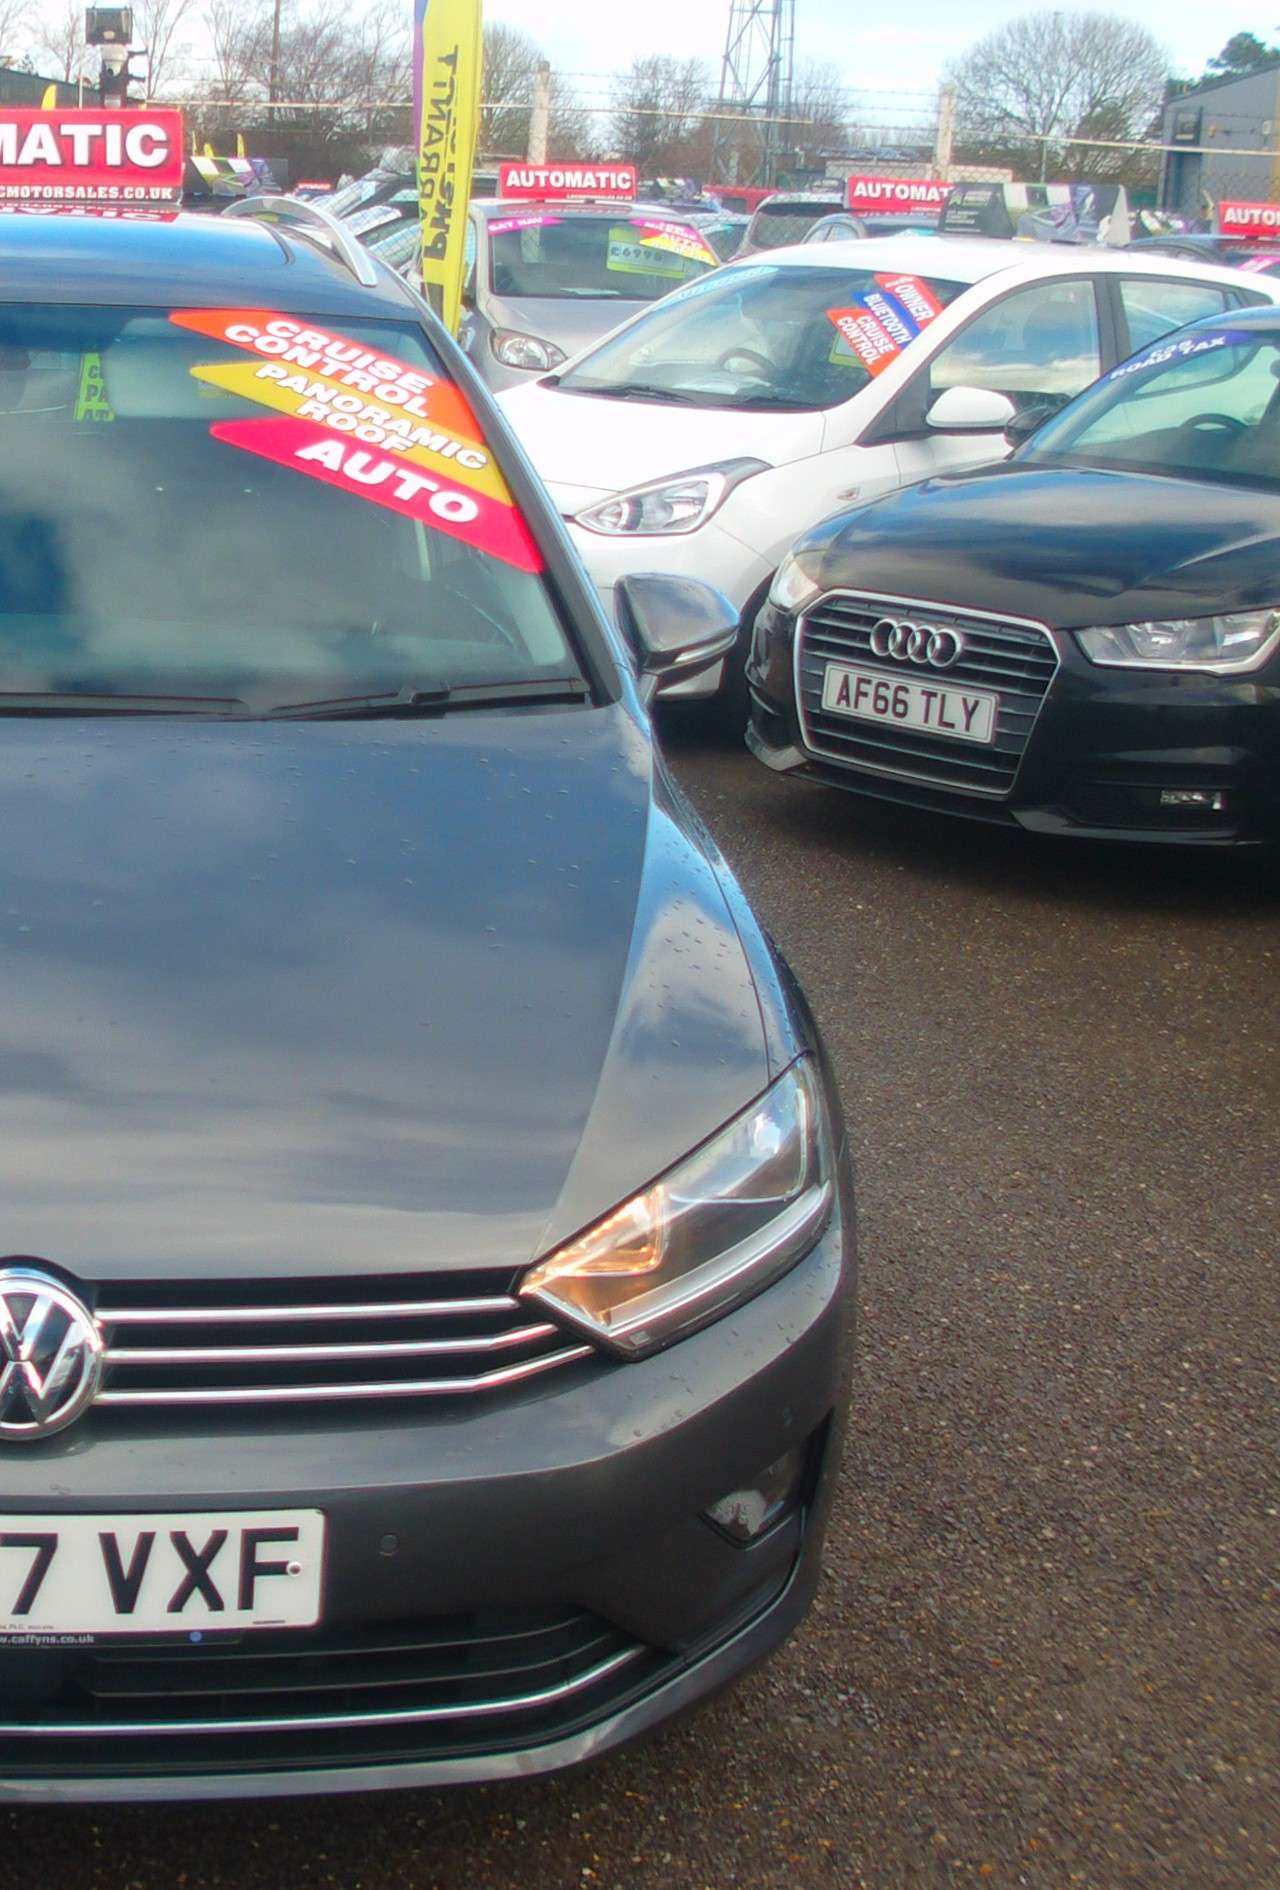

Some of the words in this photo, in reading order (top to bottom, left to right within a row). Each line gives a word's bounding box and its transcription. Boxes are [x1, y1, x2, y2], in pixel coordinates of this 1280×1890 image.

[506, 170, 633, 190] AUTOMATIC
[853, 182, 955, 201] AUTOMAT
[863, 293, 913, 345] BLUETOOTH
[894, 284, 936, 322] OWNER
[265, 320, 434, 395] CRUISE
[837, 315, 883, 366] CONTROL
[856, 315, 896, 354] CRUISE
[224, 324, 430, 418] CONTROL
[255, 363, 488, 470] PANORAMIC
[296, 401, 417, 453] ROOF
[294, 439, 479, 523] AUTO
[836, 674, 910, 719] AF66
[921, 689, 980, 733] TLY
[98, 1526, 300, 1615] VXF
